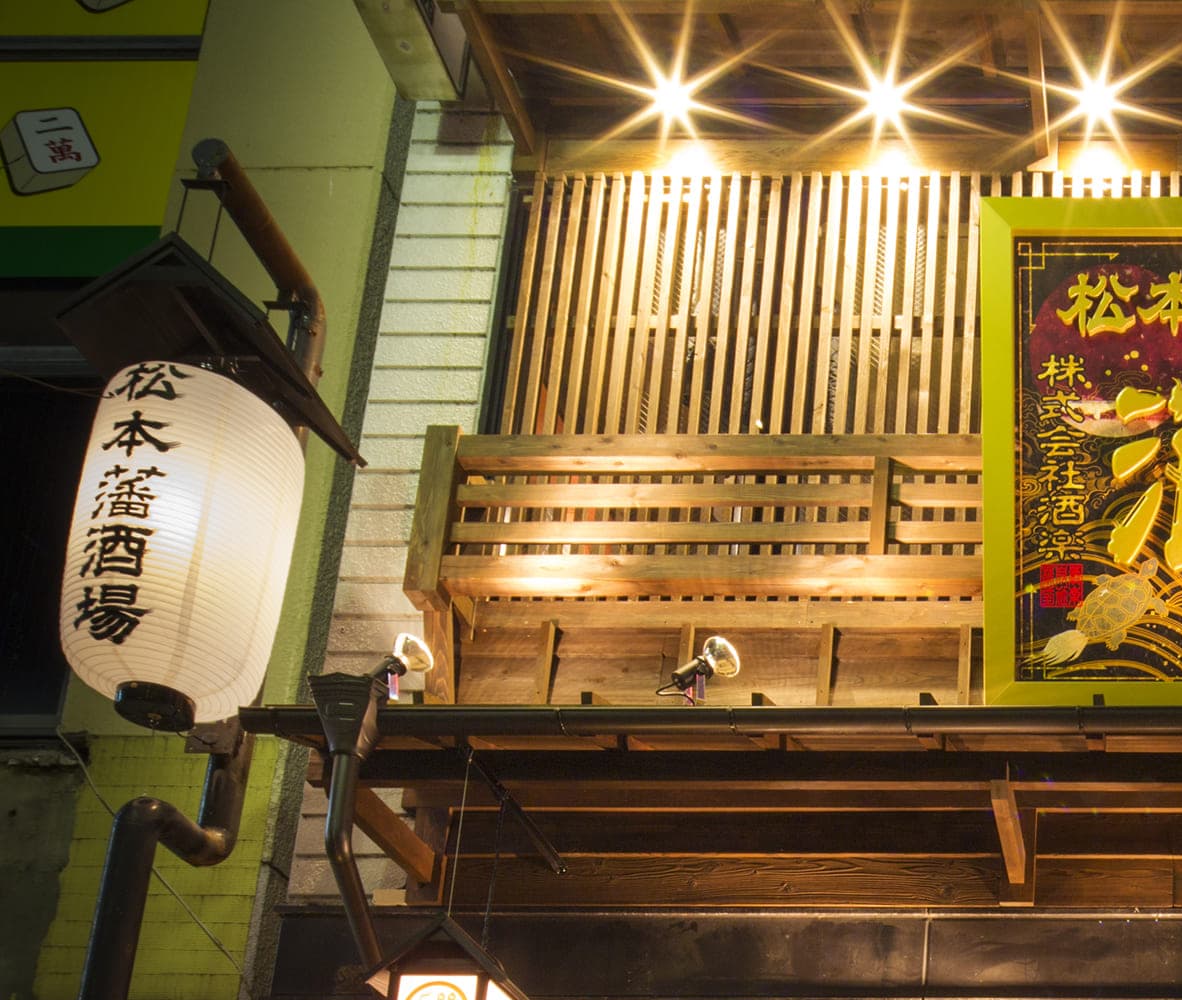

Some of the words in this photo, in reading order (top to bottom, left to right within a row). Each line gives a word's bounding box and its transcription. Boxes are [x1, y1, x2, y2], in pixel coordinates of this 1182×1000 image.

[73, 361, 191, 645] 松本藩酒場
[1037, 354, 1086, 560] 株式会社酒楽
